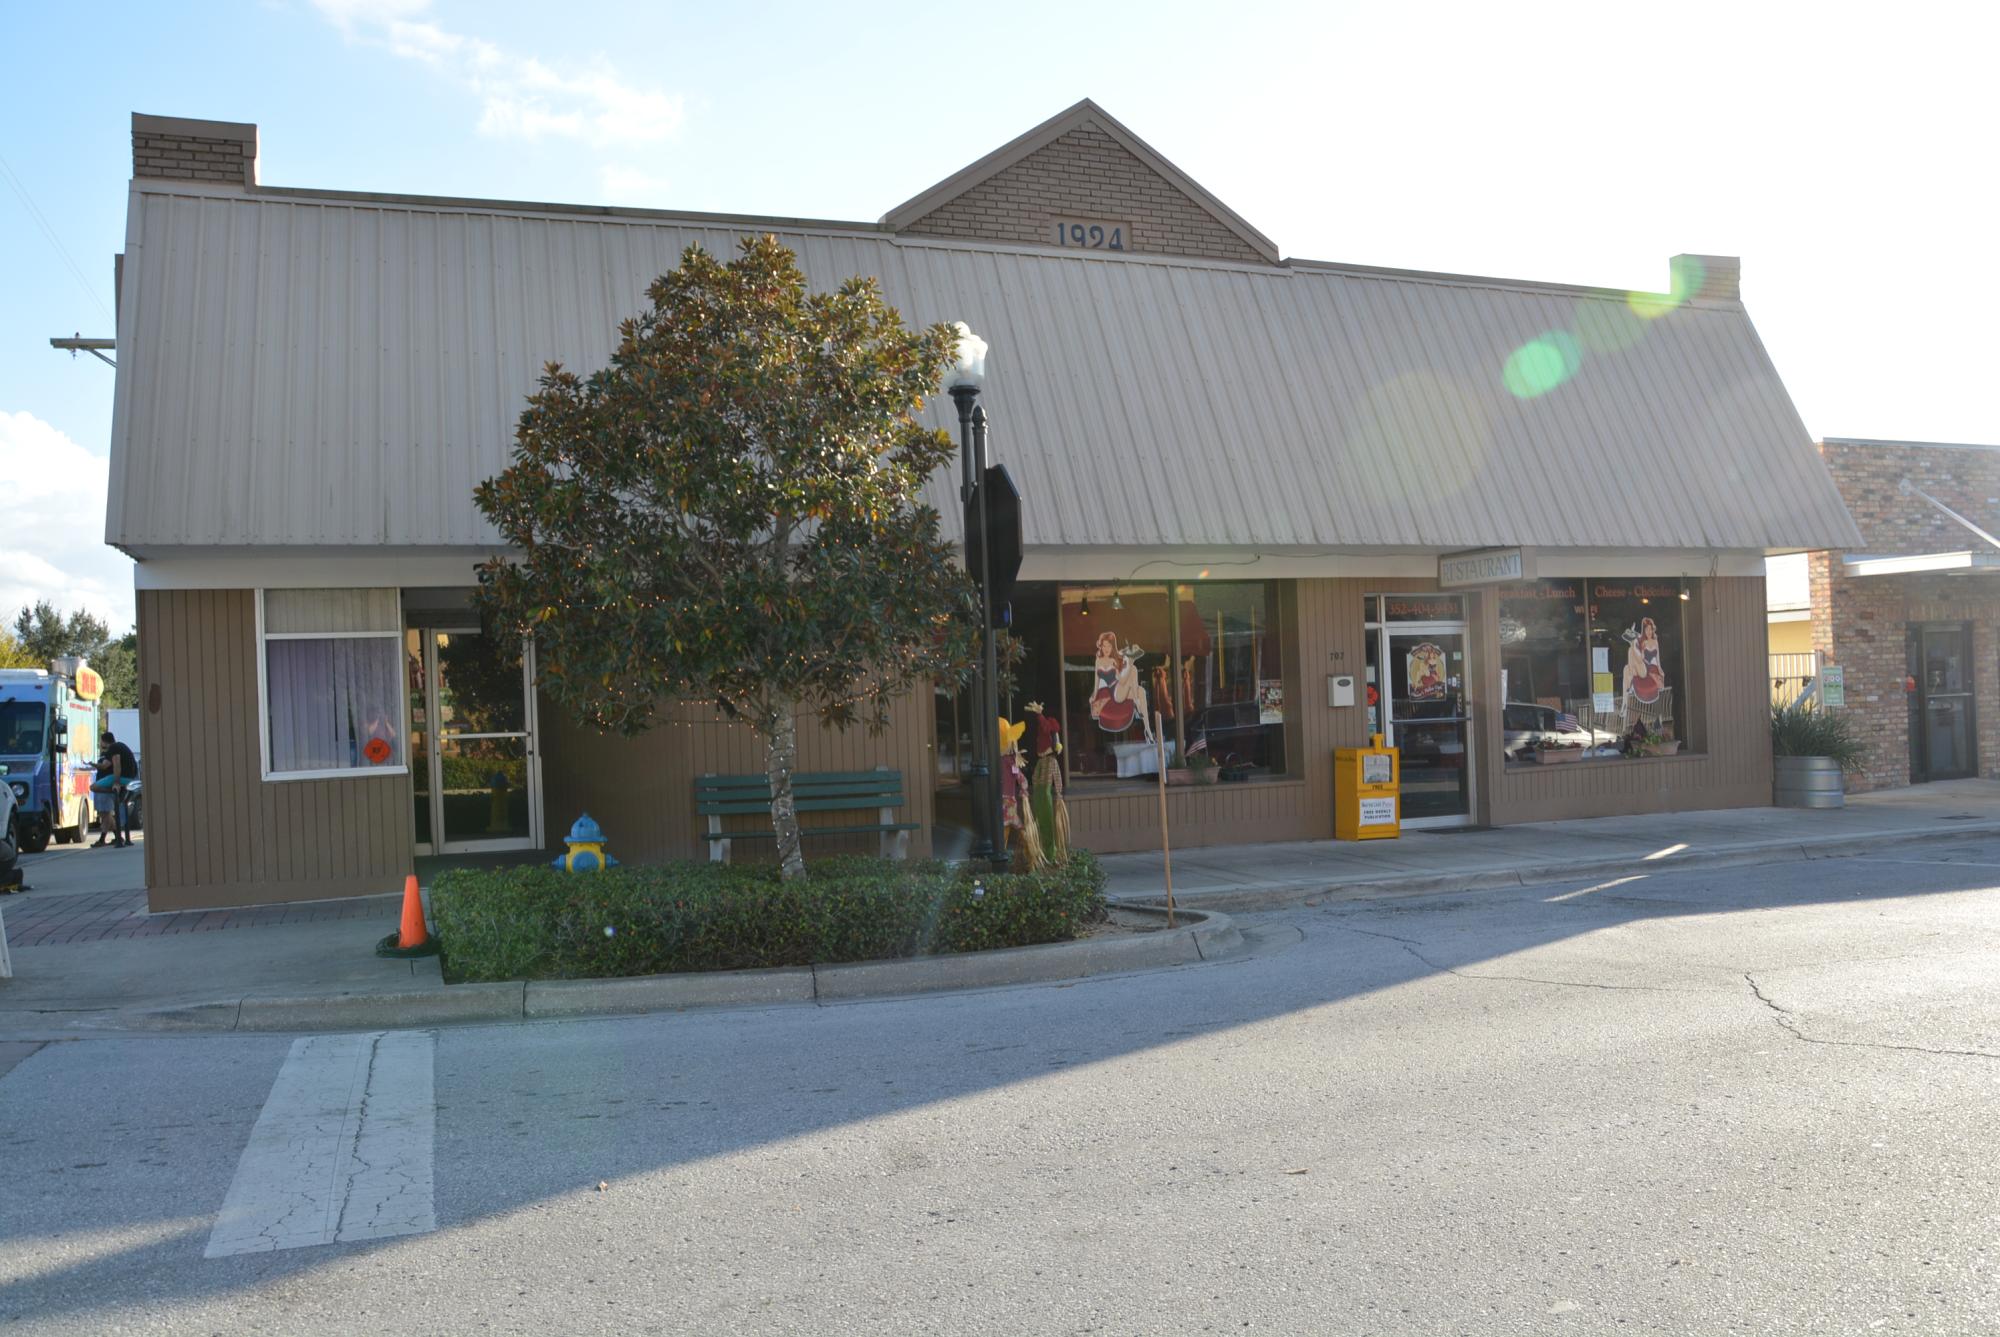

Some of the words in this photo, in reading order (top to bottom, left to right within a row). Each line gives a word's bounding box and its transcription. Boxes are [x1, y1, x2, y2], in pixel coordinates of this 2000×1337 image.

[1057, 222, 1123, 249] 1924
[1546, 586, 1576, 598] Lunch
[1595, 586, 1626, 597] Cheese
